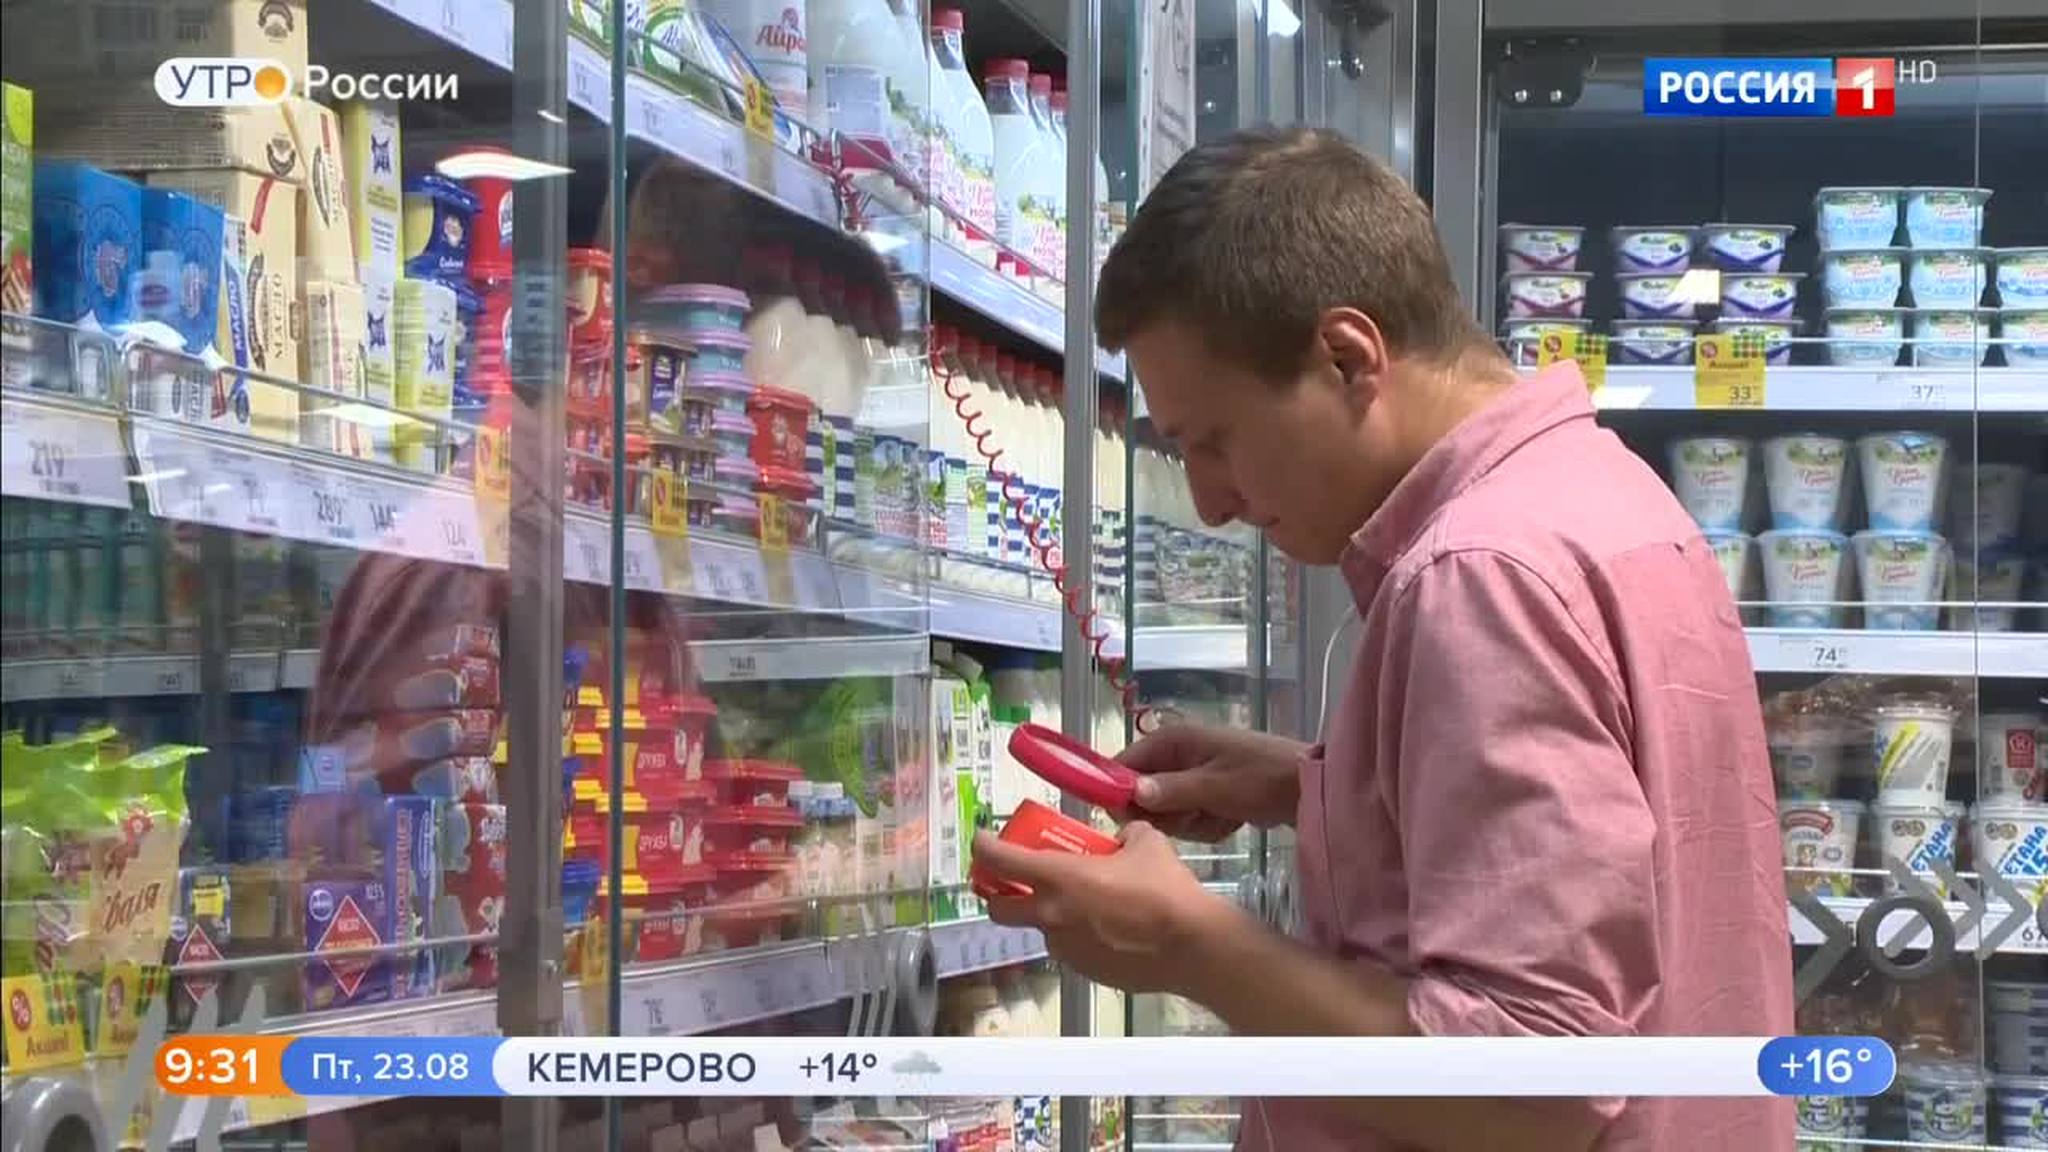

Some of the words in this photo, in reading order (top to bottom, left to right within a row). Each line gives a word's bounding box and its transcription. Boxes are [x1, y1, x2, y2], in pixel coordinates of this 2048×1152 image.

[1729, 385, 1752, 400] 33
[1910, 384, 1934, 400] 37
[1814, 646, 1838, 661] 74
[1910, 815, 1953, 872] ЕТАНА
[2003, 825, 2047, 875] ЕТАНА
